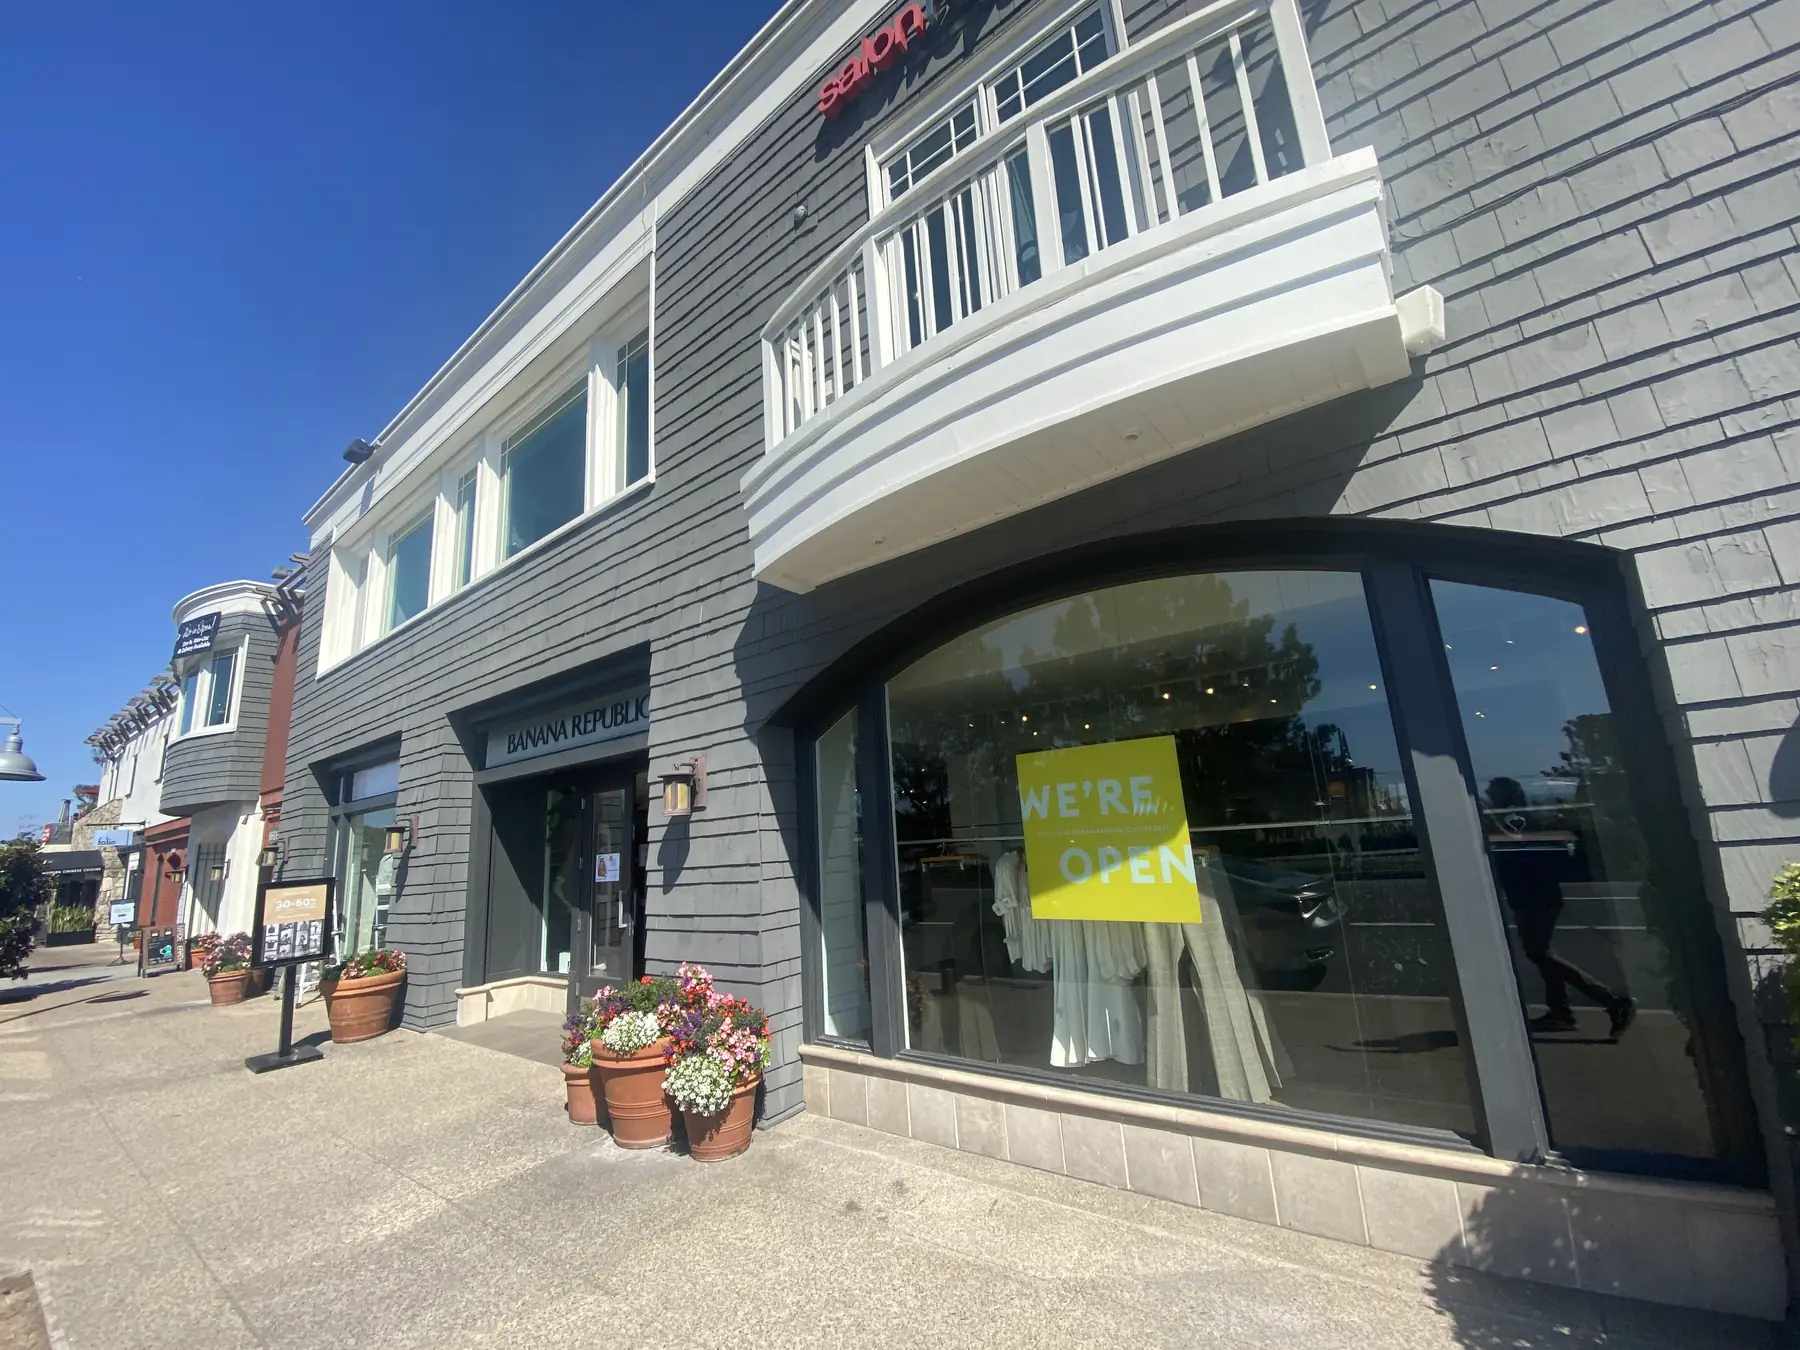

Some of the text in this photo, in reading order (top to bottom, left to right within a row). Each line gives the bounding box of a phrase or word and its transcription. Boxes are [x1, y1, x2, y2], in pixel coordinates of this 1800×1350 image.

[818, 3, 925, 117] salon
[507, 694, 650, 754] BANANA REPUBLIC
[1020, 775, 1156, 821] WE'RE
[97, 837, 117, 846] folio
[1060, 844, 1197, 885] OPEN
